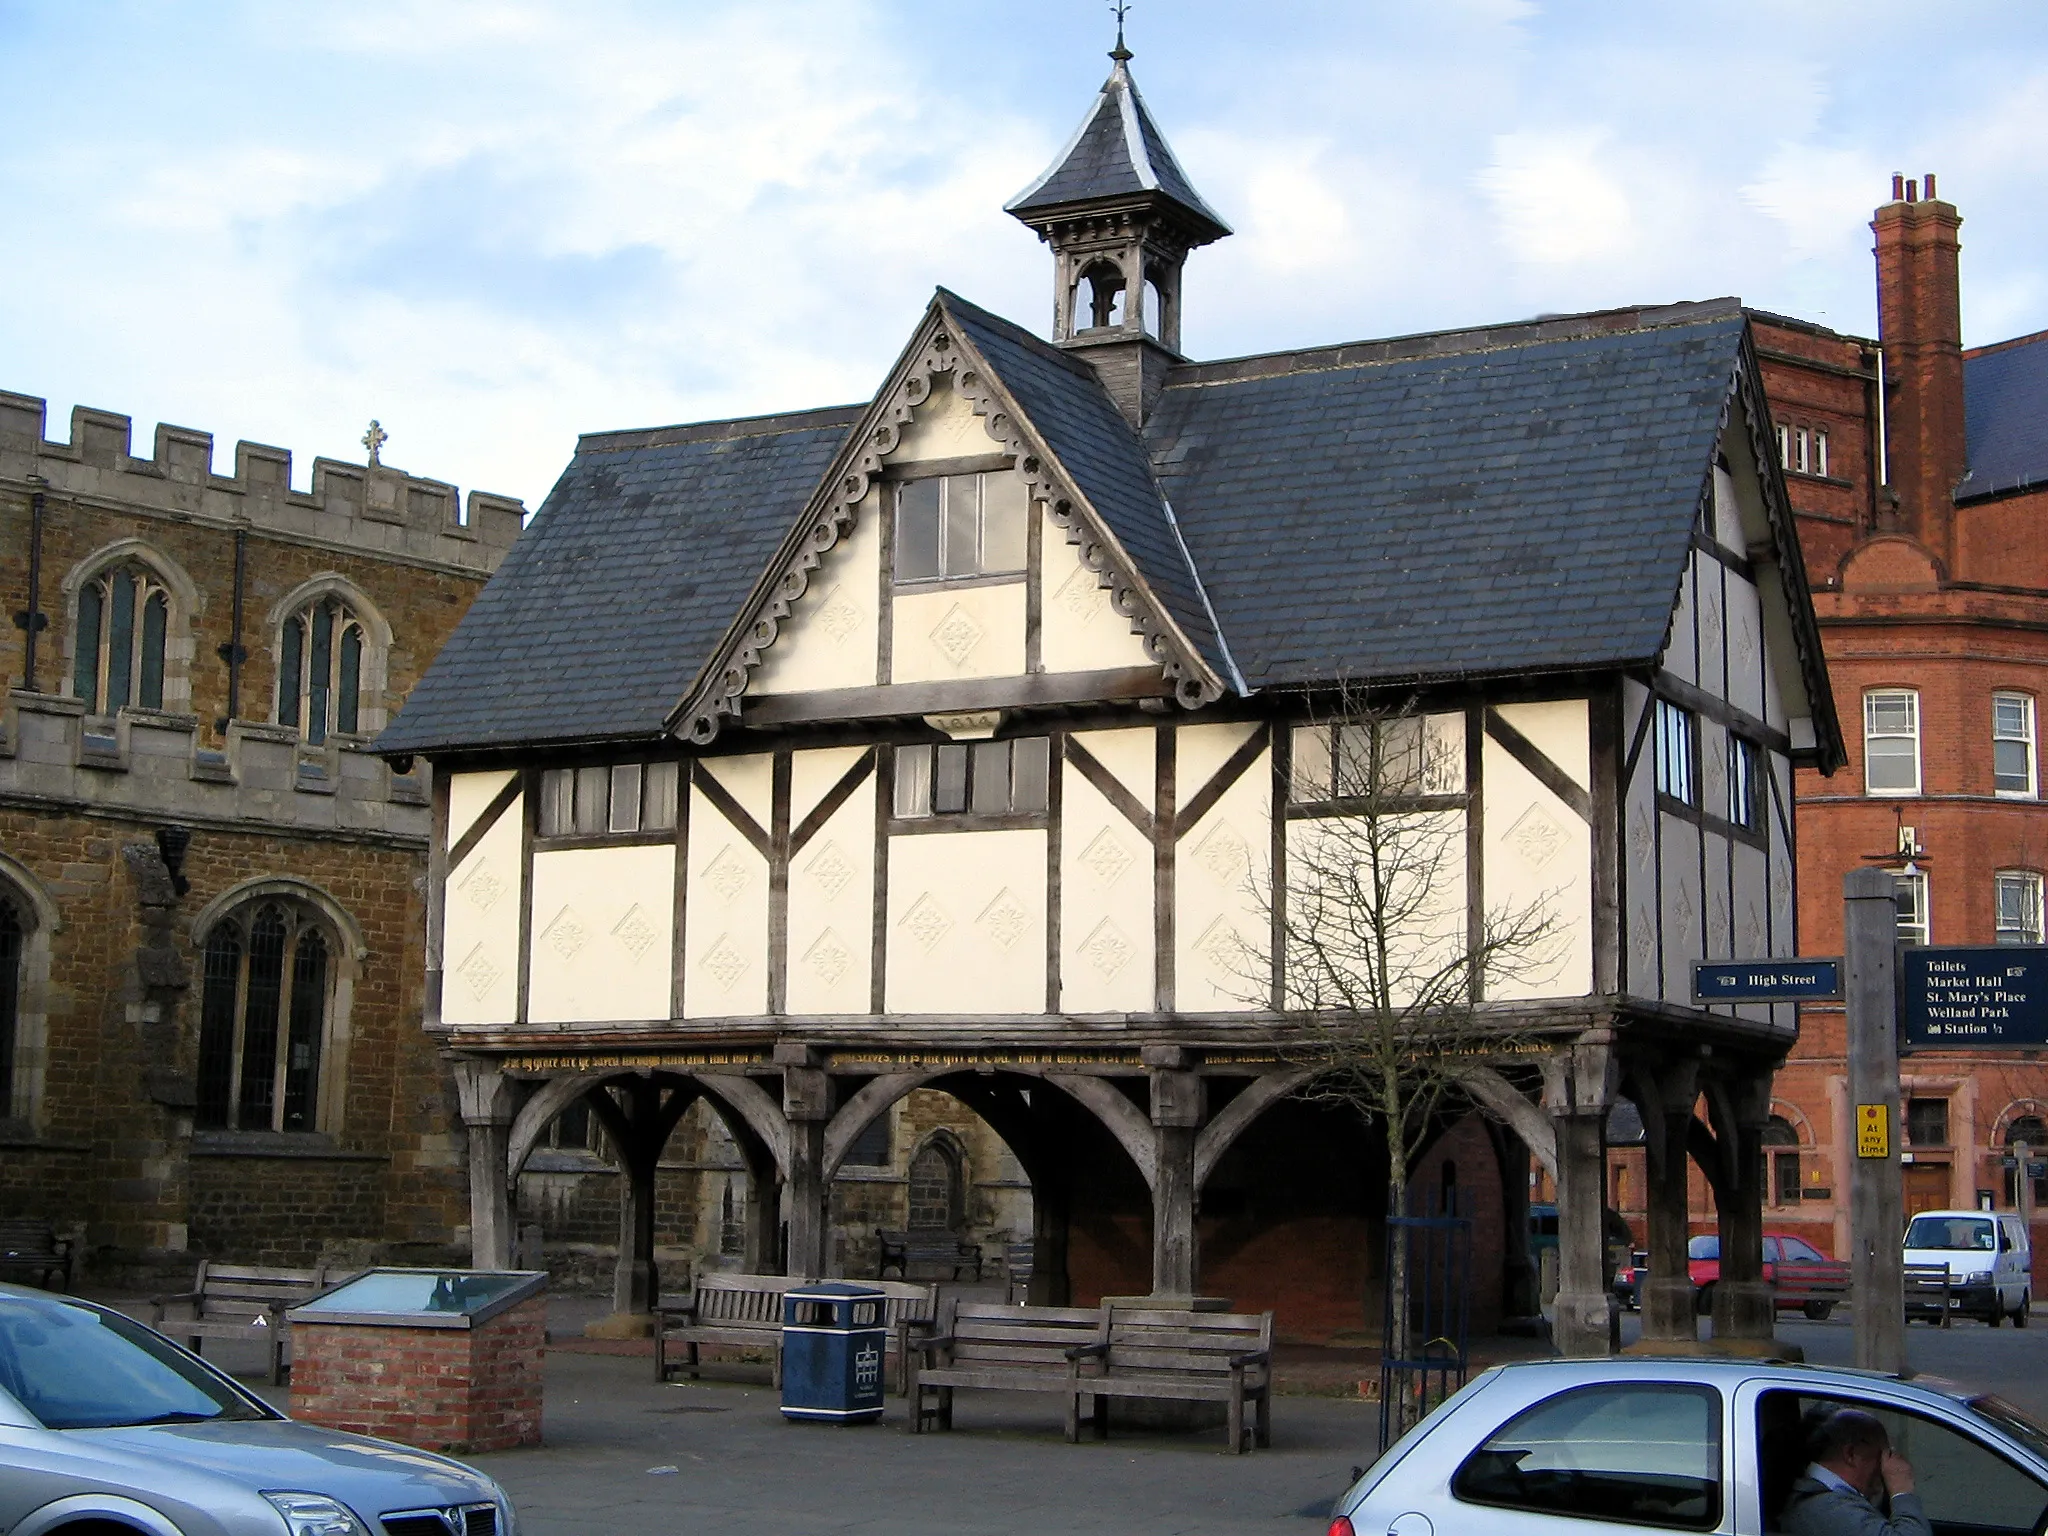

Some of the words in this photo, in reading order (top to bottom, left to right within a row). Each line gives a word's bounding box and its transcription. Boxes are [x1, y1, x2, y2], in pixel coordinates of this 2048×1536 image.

[1927, 961, 1966, 972] Toilets
[1748, 975, 1777, 987] High
[1781, 974, 1816, 985] Street
[1927, 976, 1970, 987] Market
[1975, 976, 2002, 987] Hall
[1927, 991, 1943, 1002] St.
[1948, 991, 1989, 1004] Mary's
[1994, 991, 2027, 1002] Place
[1927, 1007, 1976, 1018] Welland
[1980, 1006, 2009, 1018] Park
[1944, 1023, 1988, 1034] Station
[1867, 1124, 1877, 1132] At
